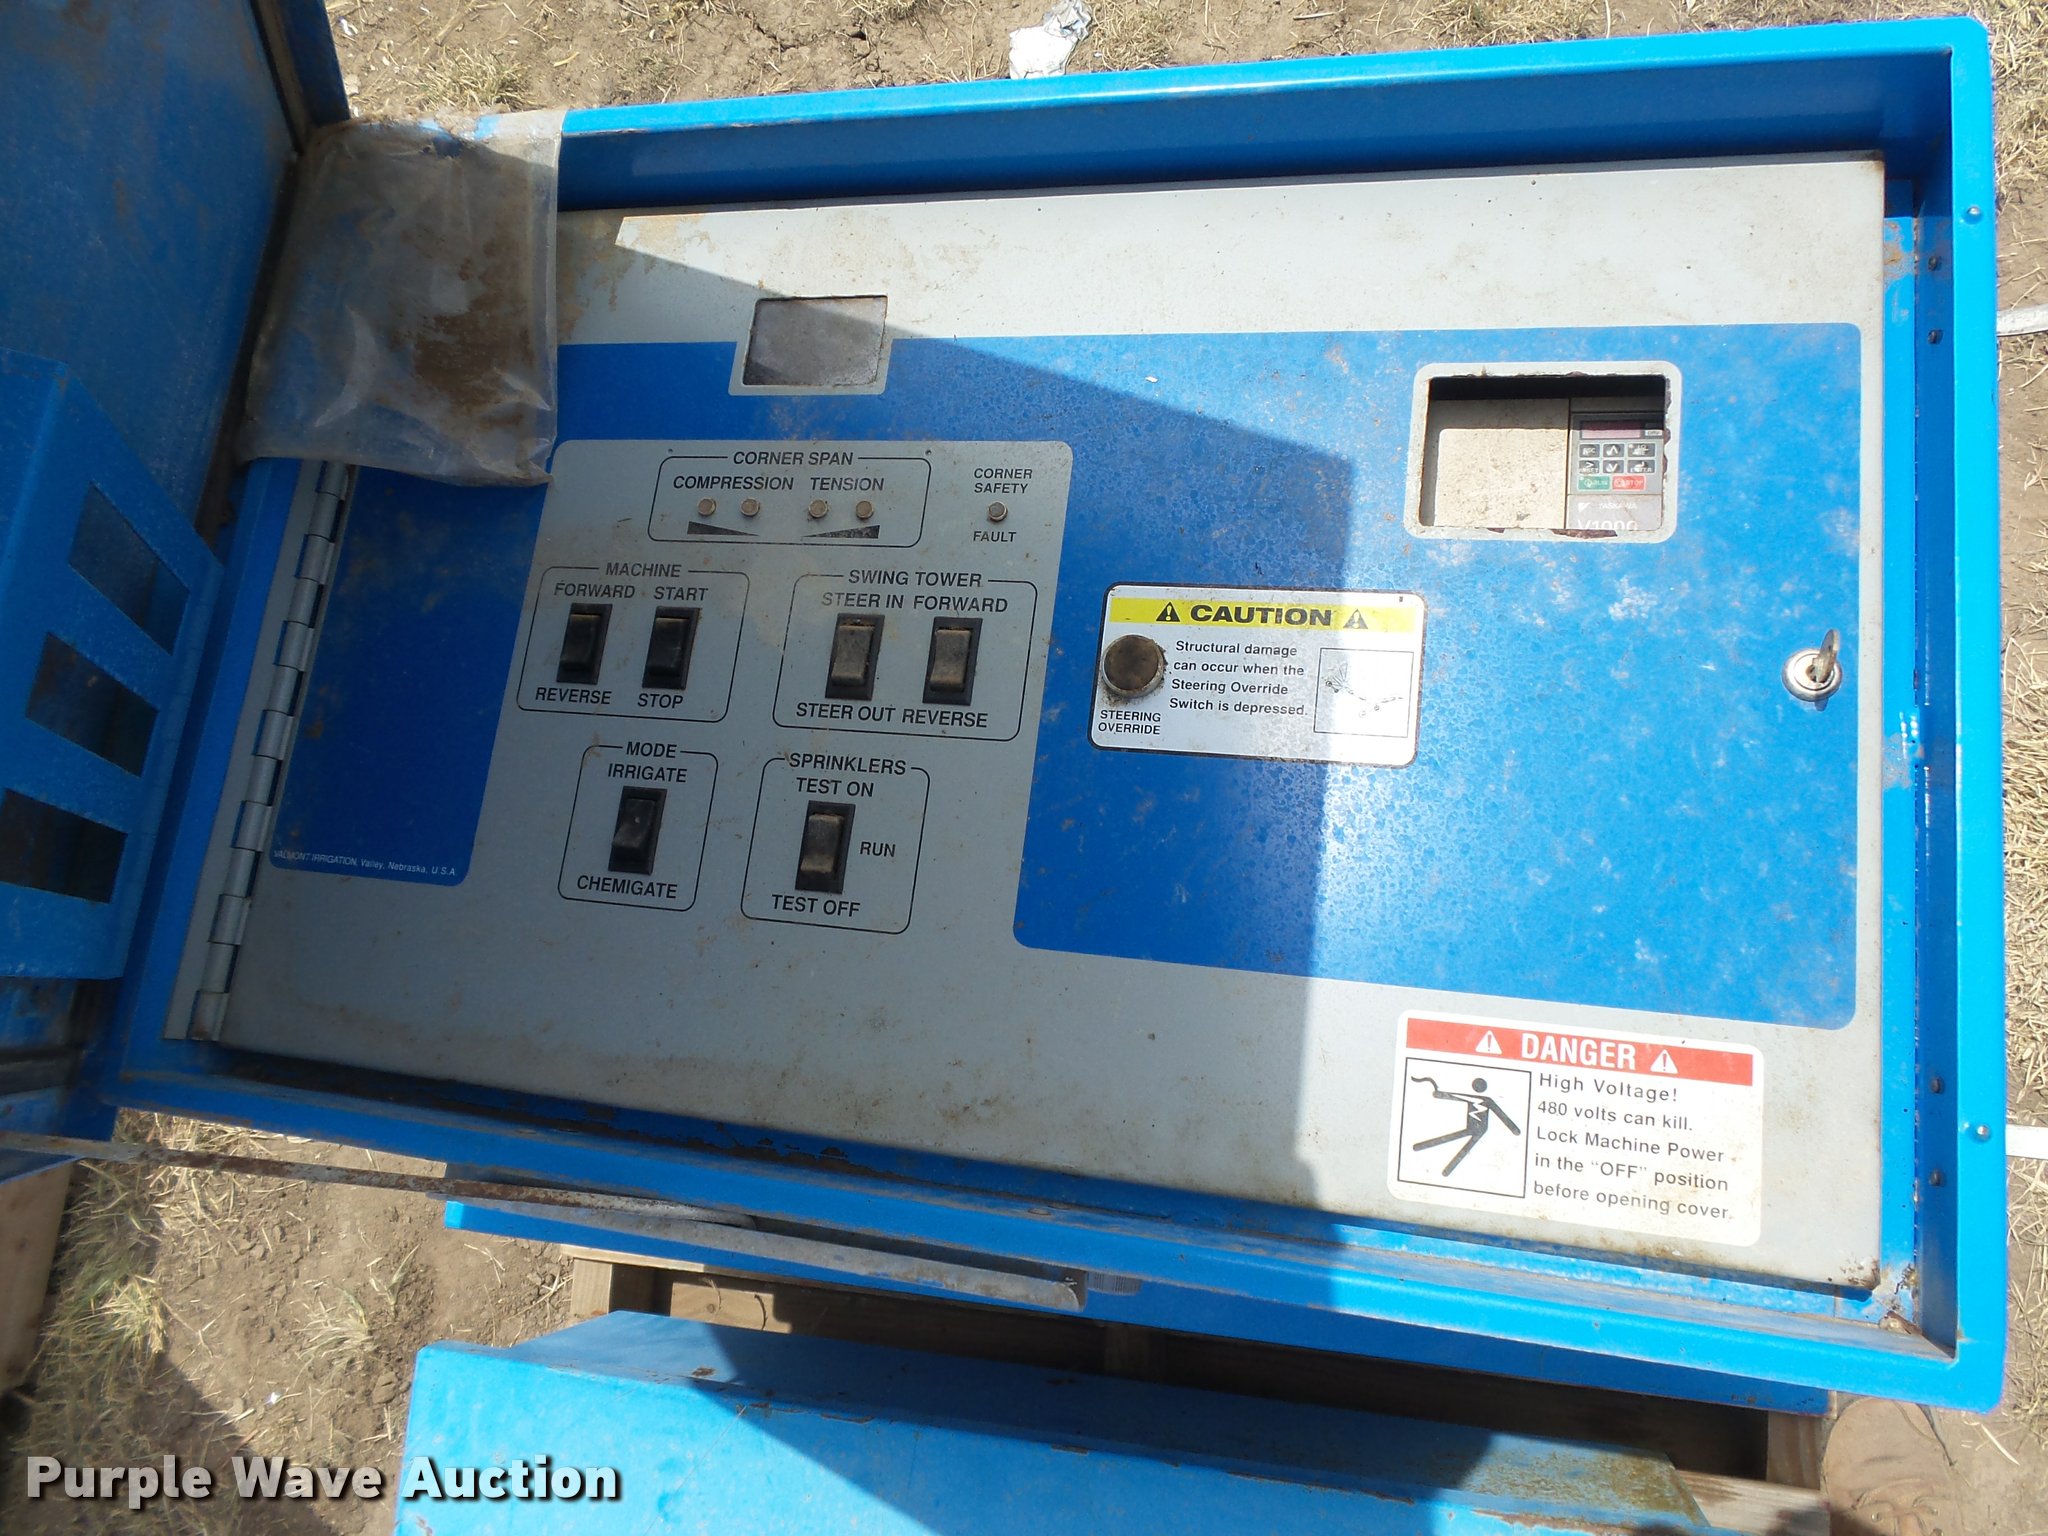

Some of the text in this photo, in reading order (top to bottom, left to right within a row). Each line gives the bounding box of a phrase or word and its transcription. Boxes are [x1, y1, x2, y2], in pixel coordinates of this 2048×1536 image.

[732, 451, 853, 466] CORNER SPAN
[973, 468, 1033, 480] CORNER
[673, 476, 884, 492] COMPRESSION TENSION
[973, 482, 1028, 493] SAFETY
[973, 531, 1017, 543] FAULT
[605, 562, 682, 578] MACHINE
[848, 571, 982, 588] SWING TOWER
[553, 582, 708, 601] FORWARD START
[821, 593, 905, 609] STEER IN
[913, 596, 1008, 613] FORWARD
[1190, 604, 1332, 627] CAUTION
[1176, 640, 1297, 657] Structural damage
[1173, 661, 1304, 676] can occur when the
[1171, 679, 1288, 695] Steering Override
[535, 688, 612, 705] REVERSE
[637, 692, 684, 708] STOP
[795, 702, 895, 723] STEER OUT
[1100, 709, 1161, 722] STEERING
[1169, 698, 1308, 717] Switch is depressed.
[902, 708, 988, 728] REVERSE
[1098, 722, 1161, 735] OVERRIDE
[626, 742, 677, 759] MODE
[789, 752, 906, 775] SPRINKLERS
[608, 763, 687, 782] IRRIGATE
[796, 777, 874, 797] TEST ON
[859, 842, 896, 857] RUN
[577, 876, 678, 898] CHEMIGATE
[772, 895, 860, 918] TEST OFF
[1521, 1033, 1637, 1070] DANGER
[1539, 1073, 1678, 1102] High Voltage!
[1538, 1101, 1693, 1131] 480 volts can kill.
[1537, 1126, 1725, 1162] Lock Machine Power
[1535, 1153, 1550, 1168] in
[1557, 1157, 1584, 1172] the
[1654, 1170, 1729, 1191] position
[1533, 1181, 1589, 1201] before
[1596, 1190, 1670, 1215] opening
